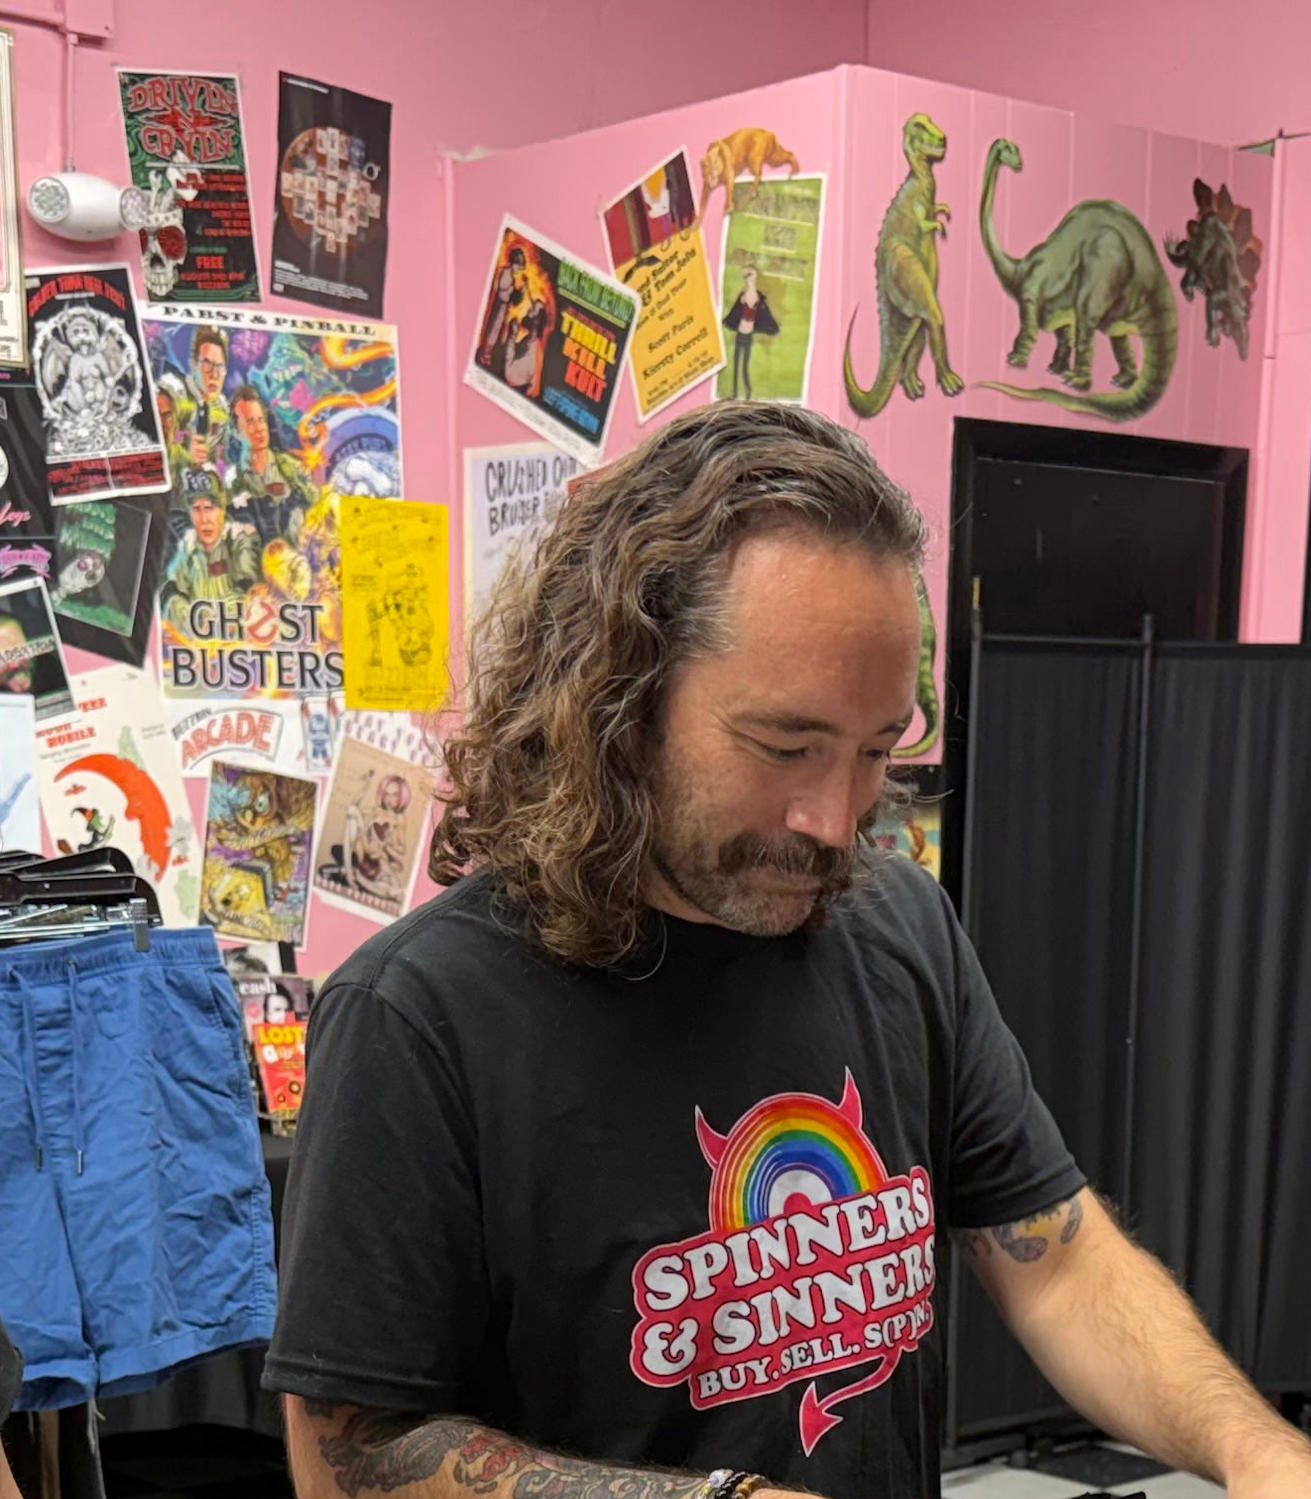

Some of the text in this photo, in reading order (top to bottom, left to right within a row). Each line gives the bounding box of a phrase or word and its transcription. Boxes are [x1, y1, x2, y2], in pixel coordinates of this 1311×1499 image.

[163, 306, 376, 337] PABST & PINBALL
[172, 647, 345, 690] BUSTERS
[182, 711, 275, 770] ARCADE
[258, 1026, 305, 1045] LOST
[642, 1176, 931, 1312] SPINNERS
[641, 1235, 935, 1377] & SINNERS
[697, 1355, 780, 1400] BUY.
[780, 1332, 862, 1374] SELL.
